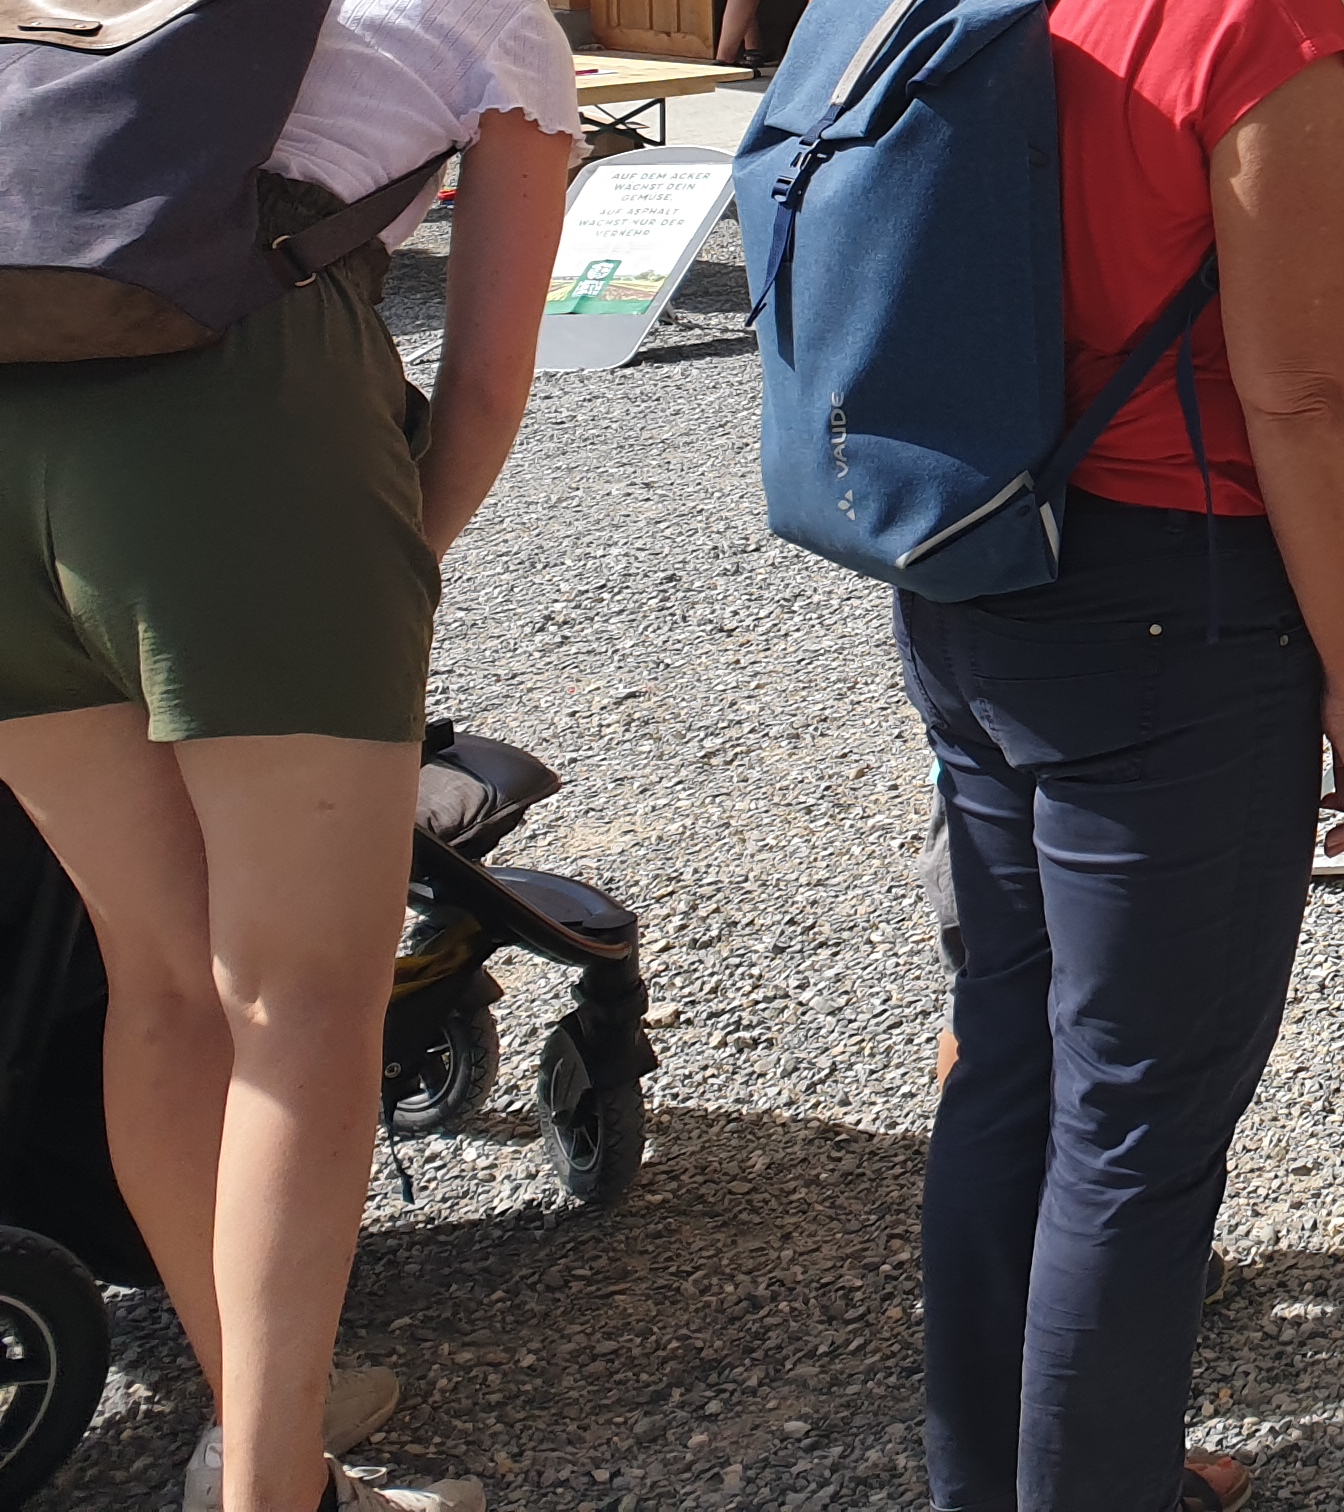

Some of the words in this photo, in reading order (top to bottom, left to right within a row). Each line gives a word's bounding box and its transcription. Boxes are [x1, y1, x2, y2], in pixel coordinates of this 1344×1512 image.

[640, 172, 667, 180] DEM
[670, 172, 711, 180] ACKER
[665, 182, 696, 190] DEIN
[660, 218, 685, 226] DER
[830, 391, 849, 478] VAUDE
